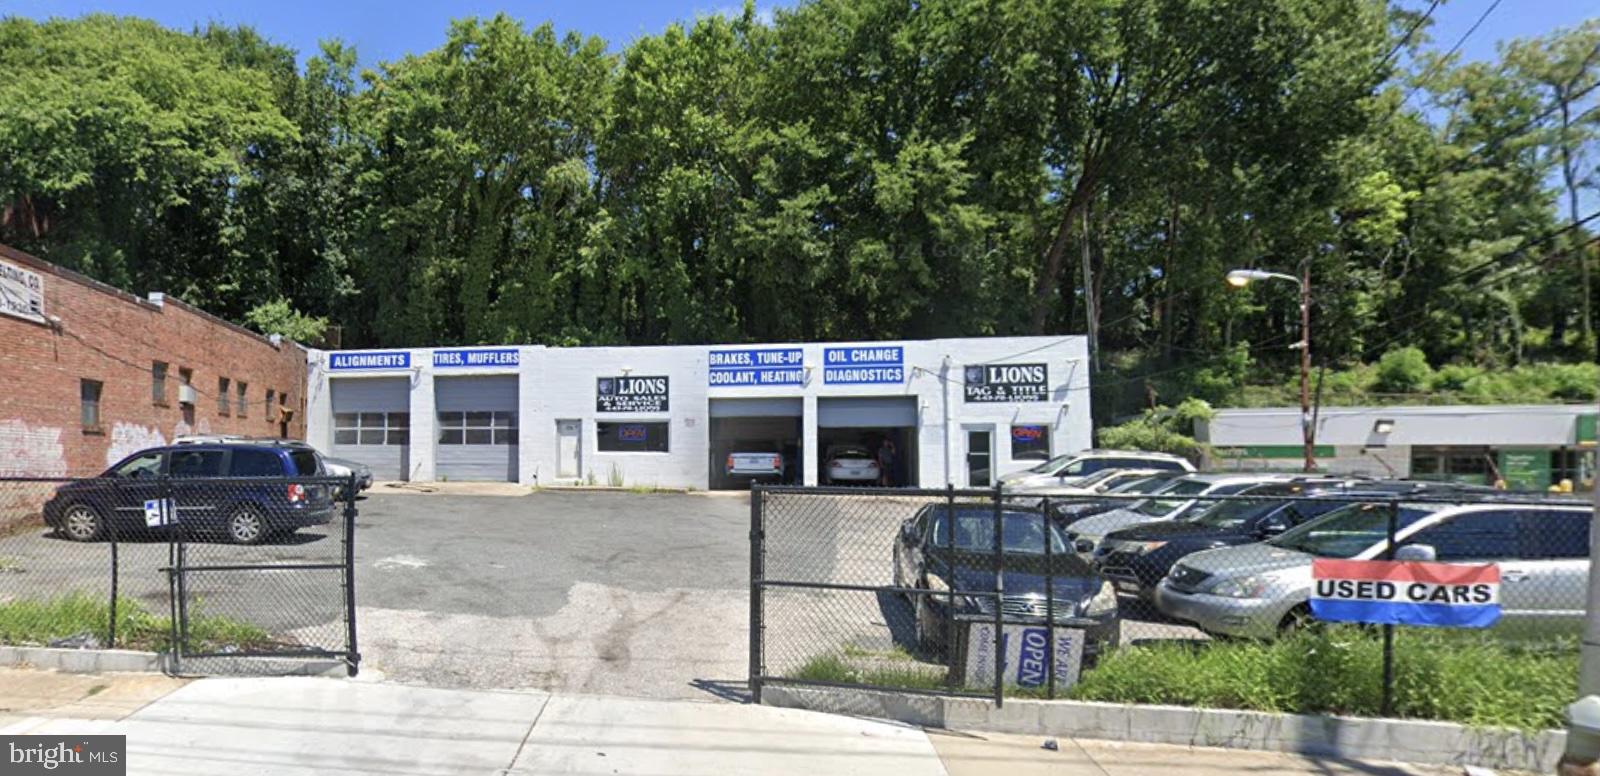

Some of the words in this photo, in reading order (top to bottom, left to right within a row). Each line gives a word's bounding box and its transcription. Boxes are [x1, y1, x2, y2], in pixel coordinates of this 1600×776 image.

[334, 354, 405, 367] ALIGNMENTS
[434, 352, 465, 365] TIRES,
[467, 351, 519, 364] MUFFLERS
[710, 352, 754, 366] BRAKES,
[757, 351, 802, 364] TUNE-UP
[828, 350, 848, 363] OIL
[851, 348, 899, 362] CHANGE
[709, 371, 758, 384] COOLANT,
[760, 370, 803, 383] HEATING
[826, 368, 902, 382] DIAGNOSTICS
[990, 365, 1044, 384] LIONS
[618, 379, 667, 395] LIONS
[966, 385, 991, 396] TAG
[1011, 384, 1047, 395] TITLE
[1316, 579, 1396, 600] USED
[1407, 582, 1492, 603] CARS
[1021, 632, 1046, 684] OPEN
